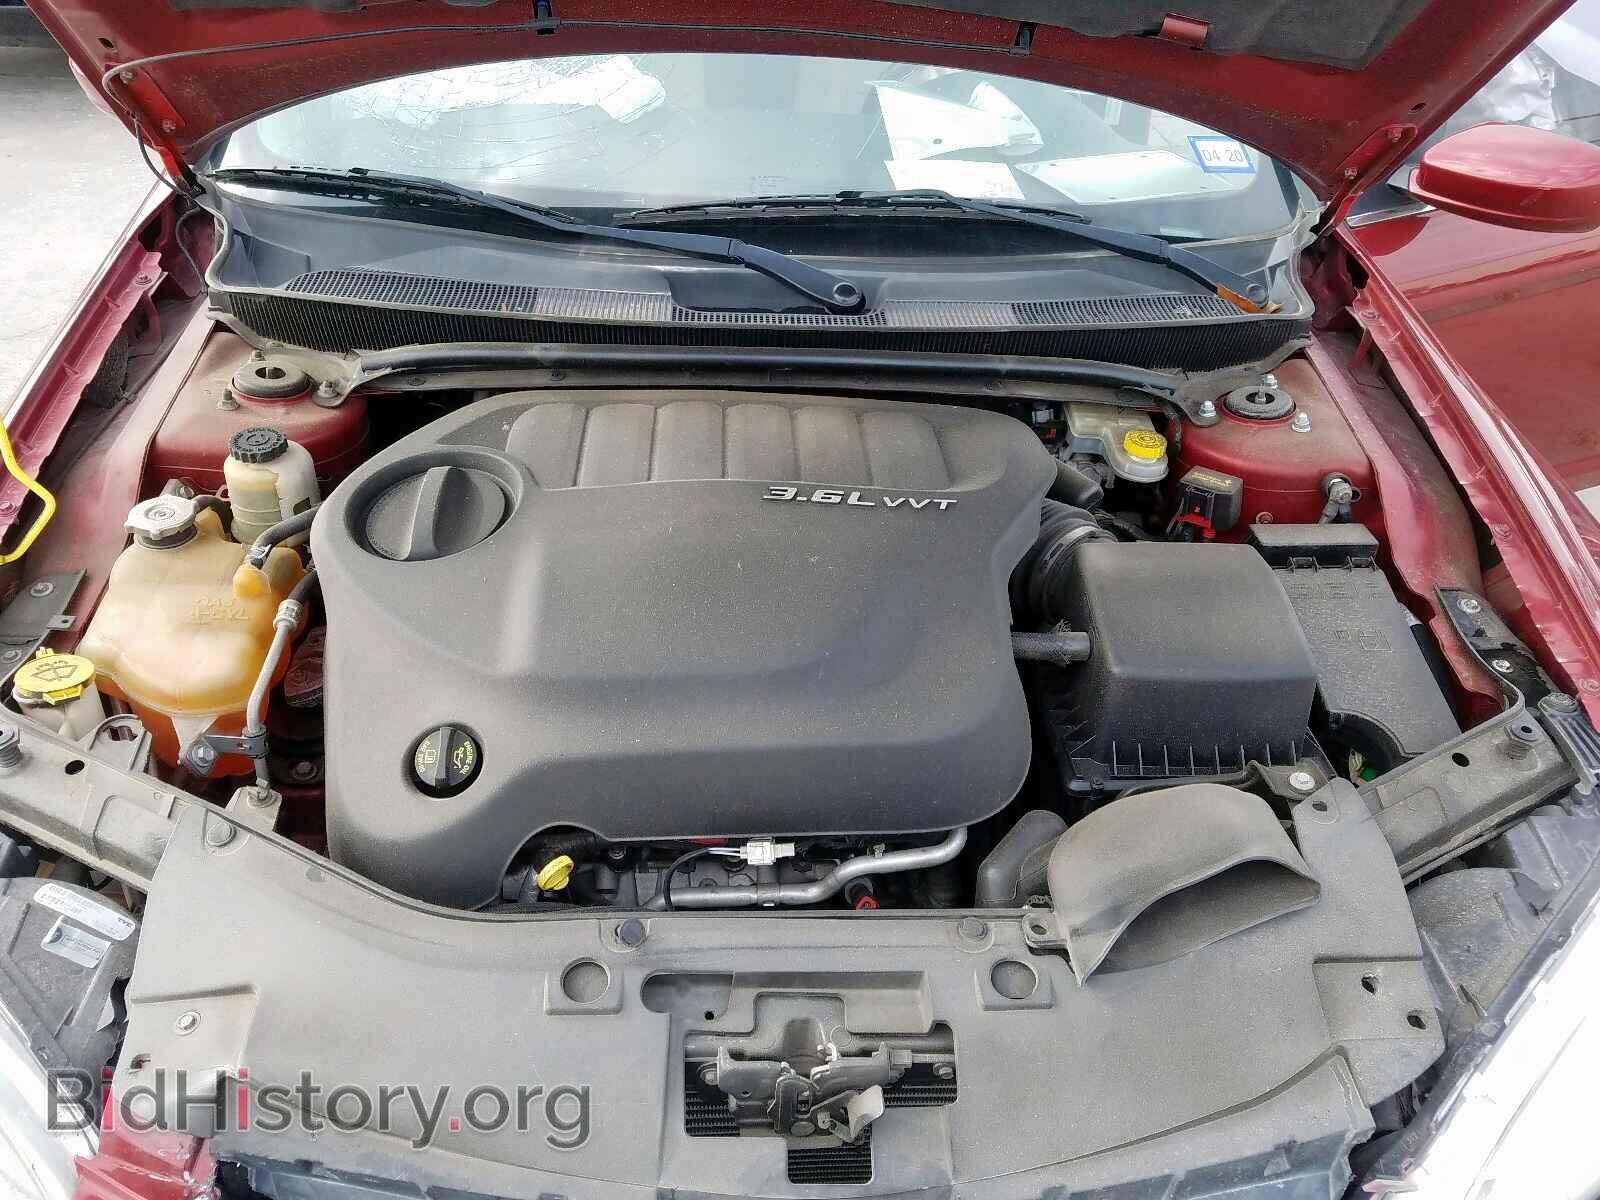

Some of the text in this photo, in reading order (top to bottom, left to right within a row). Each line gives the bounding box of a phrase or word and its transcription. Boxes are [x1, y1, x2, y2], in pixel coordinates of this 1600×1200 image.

[1225, 149, 1244, 161] 20
[762, 486, 957, 510] 3.6L VVT
[460, 741, 473, 775] ENGINE OIL
